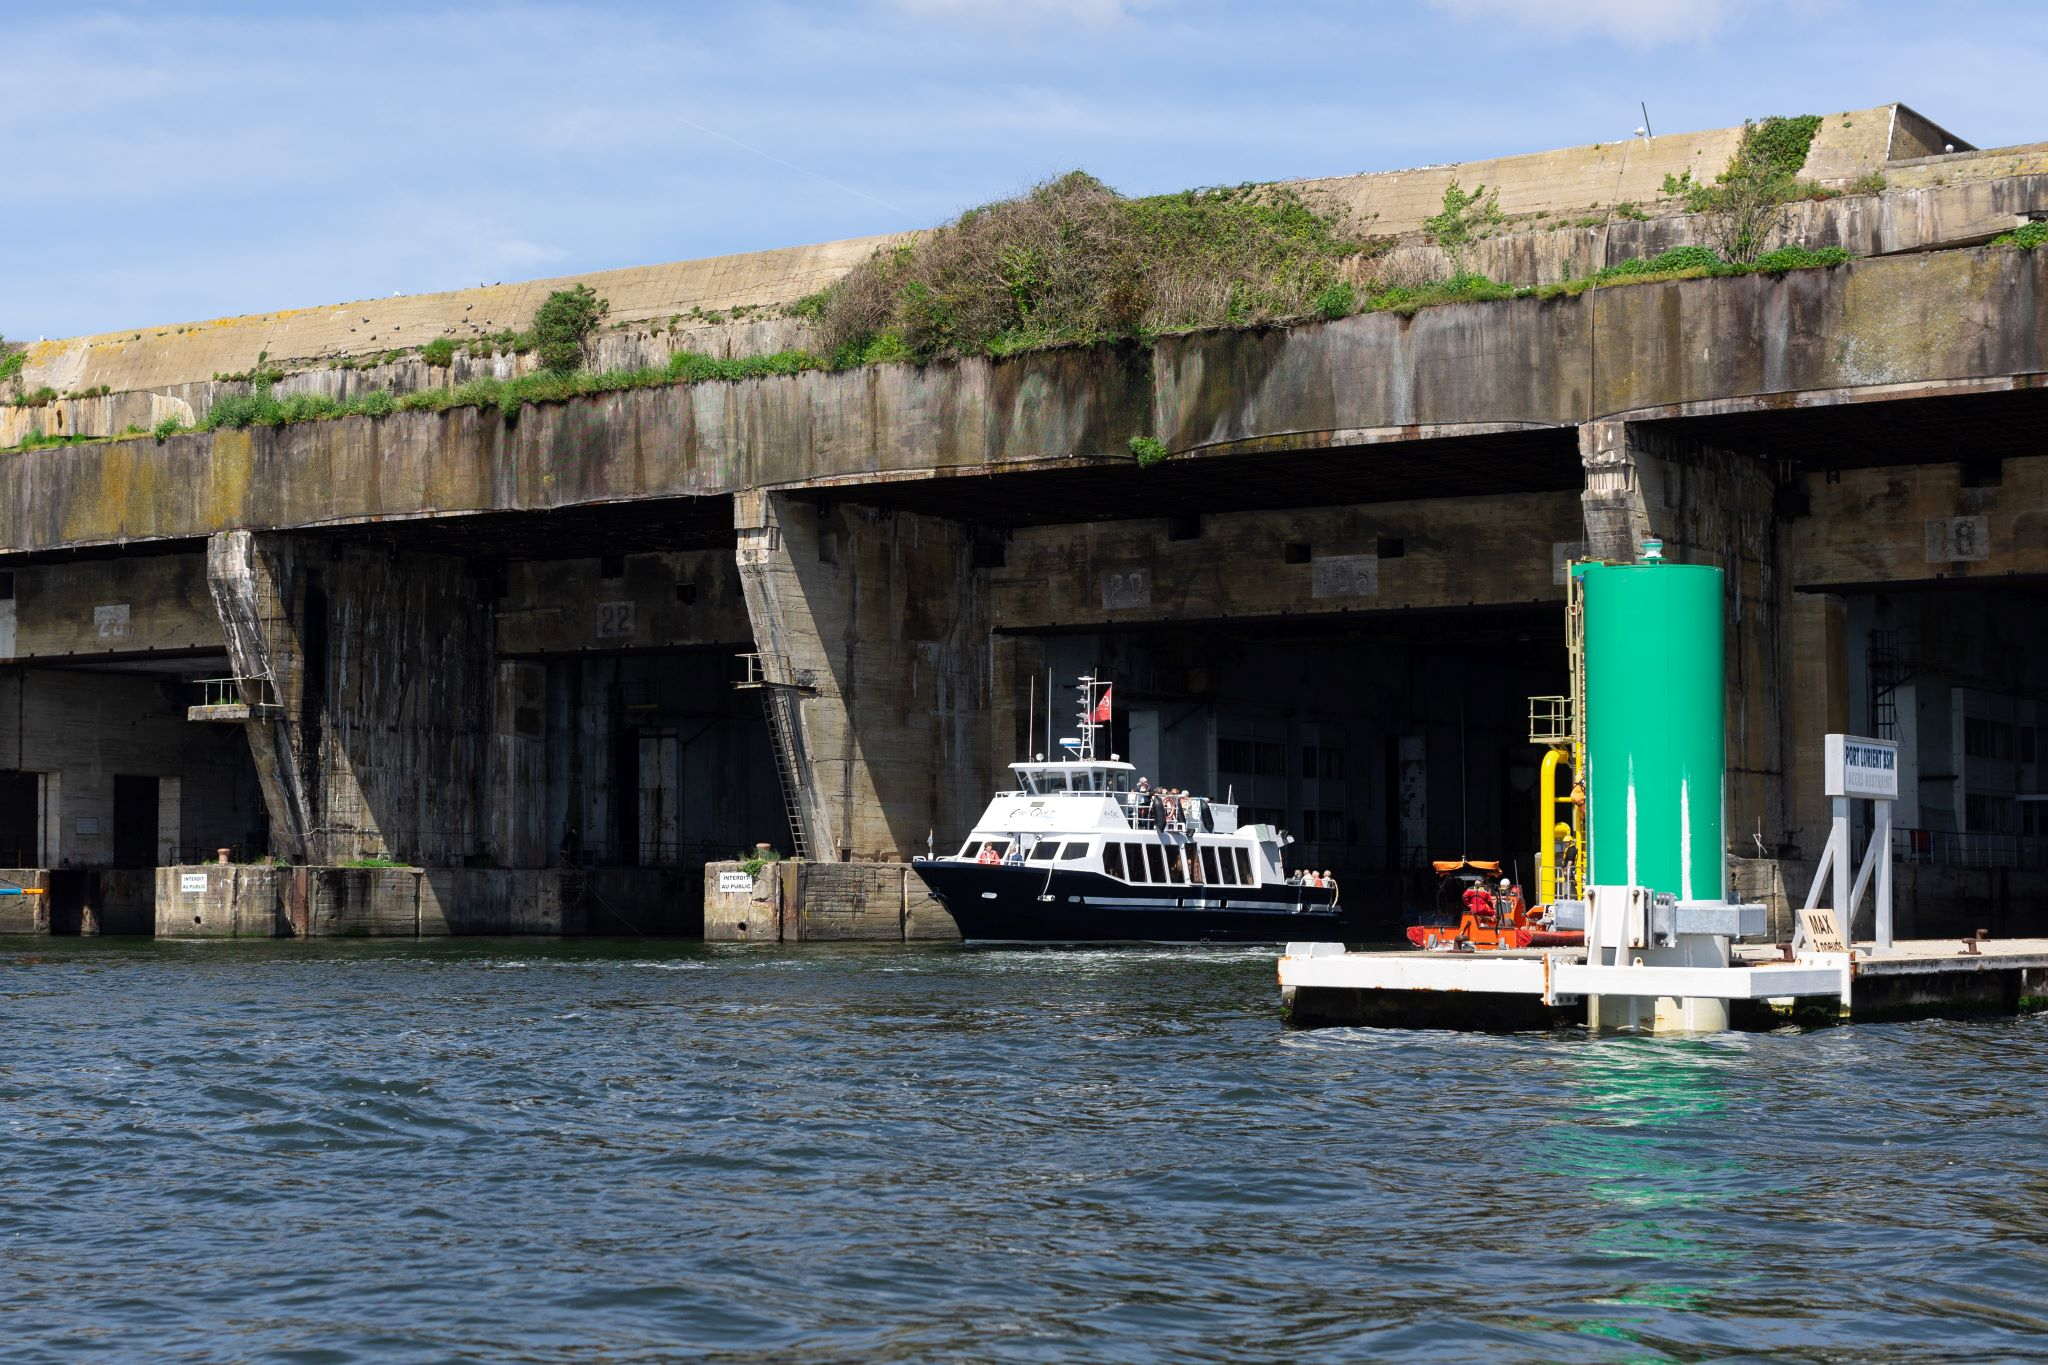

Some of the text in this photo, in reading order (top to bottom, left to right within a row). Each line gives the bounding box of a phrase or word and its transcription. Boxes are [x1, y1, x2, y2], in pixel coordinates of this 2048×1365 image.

[602, 605, 630, 633] 22
[1845, 745, 1896, 771] PORT LORIENT BSM
[1808, 914, 1834, 935] MAX
[1812, 938, 1821, 953] 3
